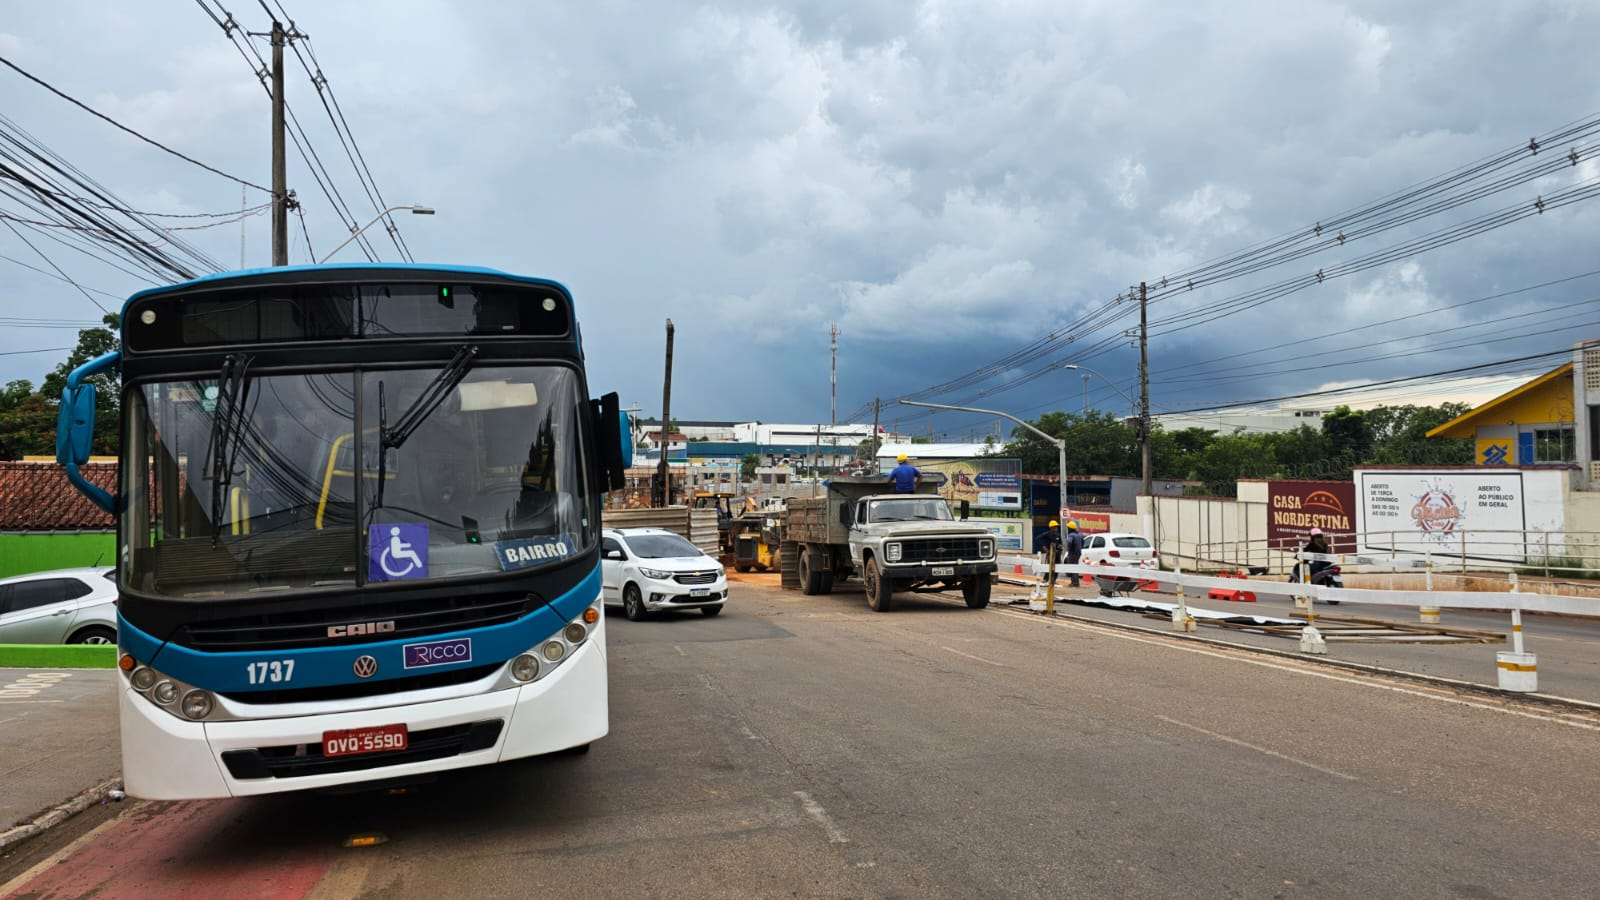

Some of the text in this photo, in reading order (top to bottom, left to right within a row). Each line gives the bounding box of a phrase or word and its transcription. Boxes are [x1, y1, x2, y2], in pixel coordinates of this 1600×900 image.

[1273, 495, 1302, 510] CASA
[1274, 511, 1350, 530] NORDESTINA
[505, 542, 568, 563] BAIRRO
[327, 620, 395, 638] CAIO
[411, 643, 467, 664] RICCO
[247, 659, 295, 685] 1737
